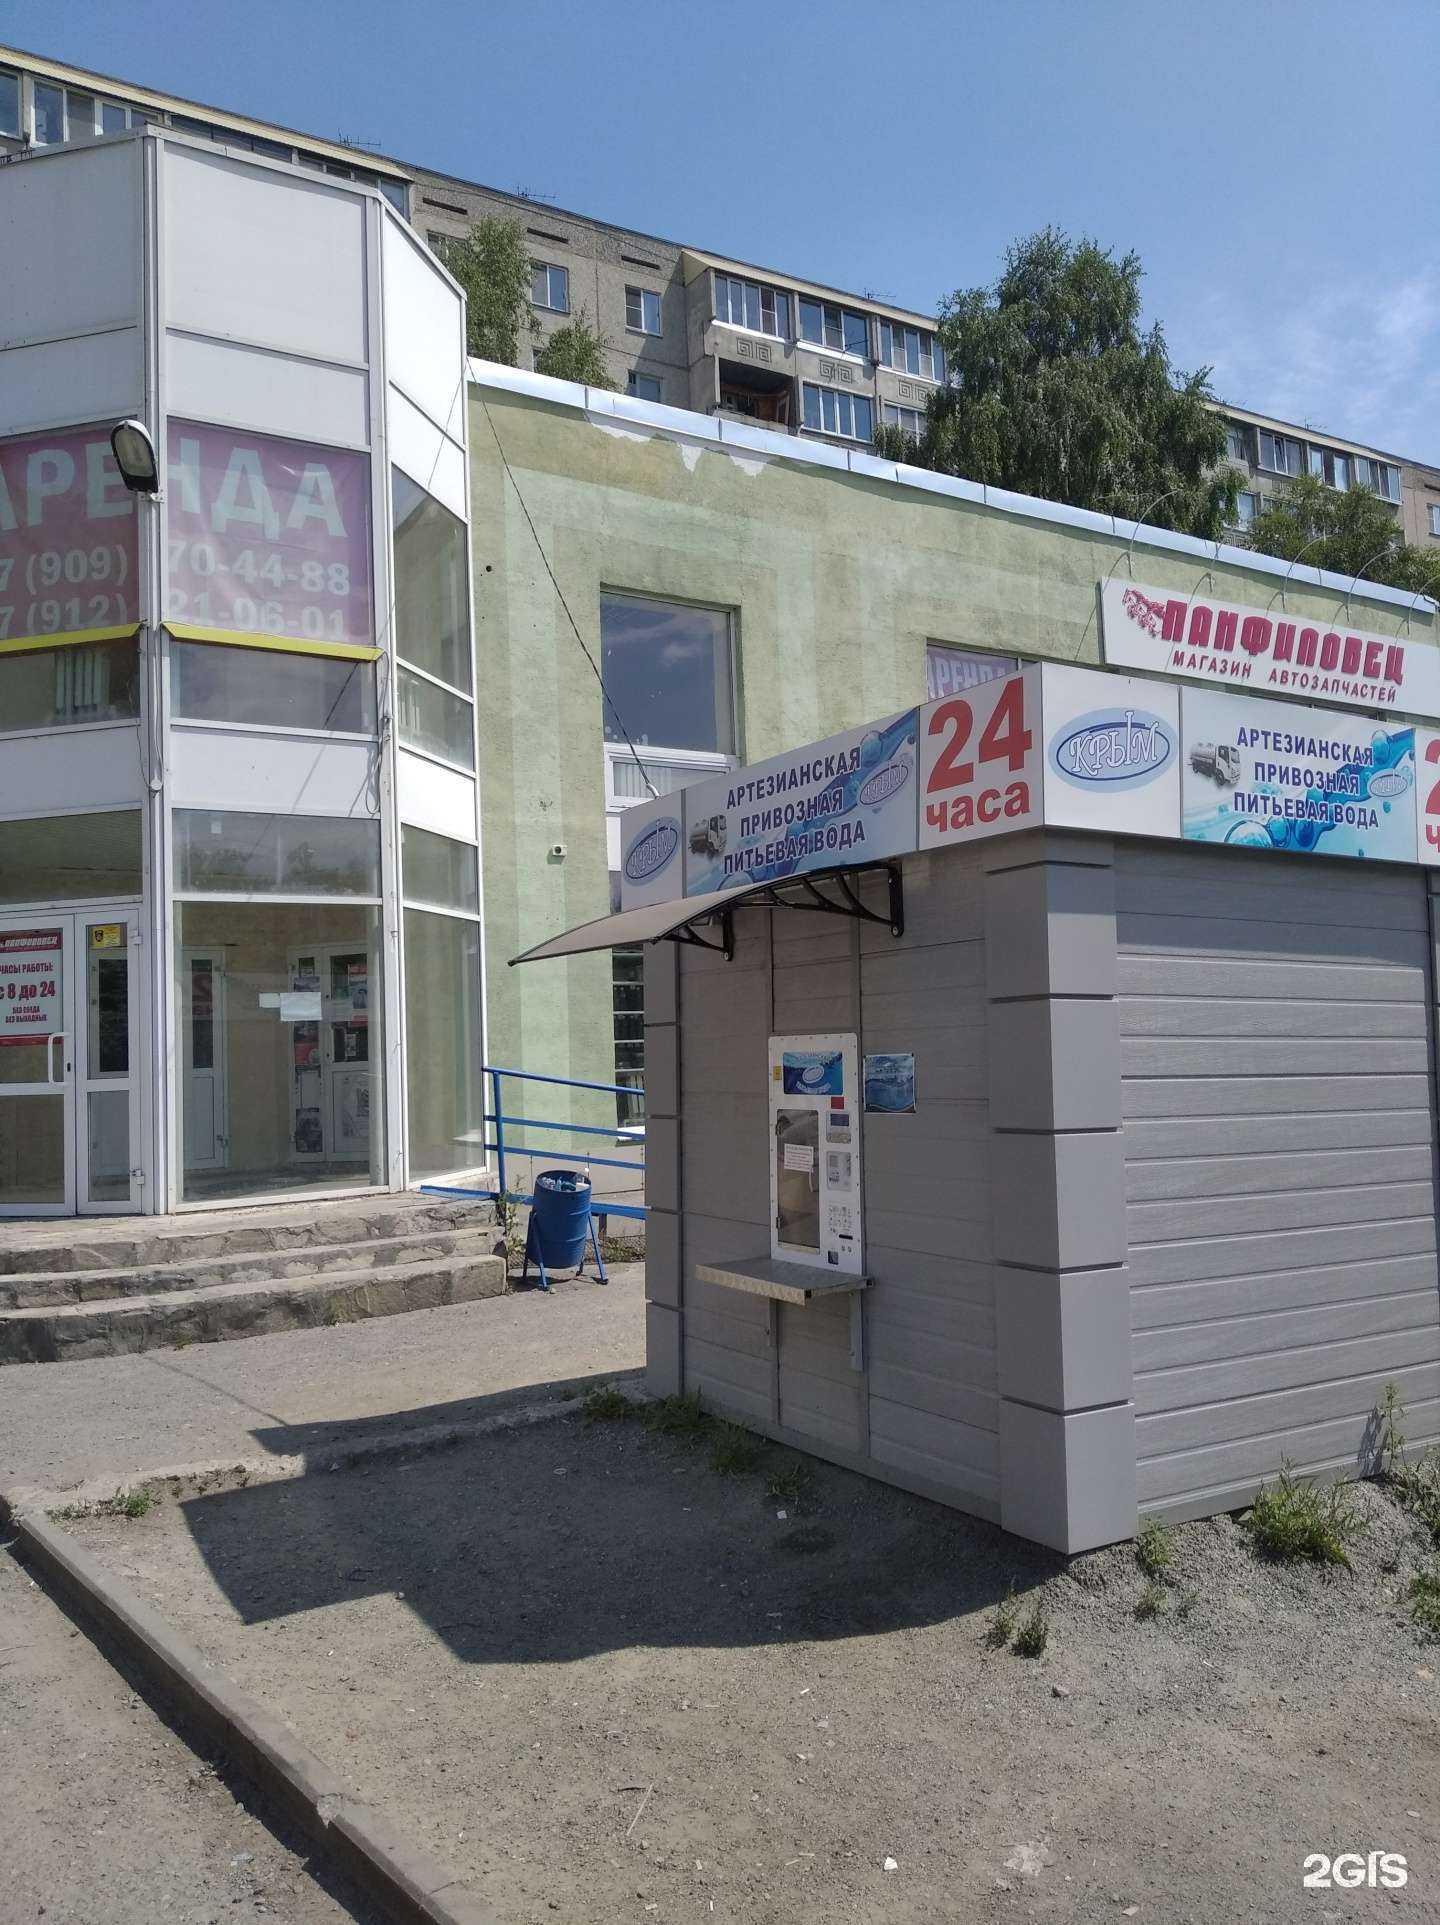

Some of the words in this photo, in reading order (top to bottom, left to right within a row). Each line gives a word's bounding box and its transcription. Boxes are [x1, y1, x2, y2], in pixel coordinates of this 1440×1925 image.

[26, 544, 128, 596] (909)
[26, 592, 128, 636] (912)
[1160, 598, 1405, 686] ПАНФИЛОВЕЦ
[1172, 650, 1253, 679] МАГАЗИН
[1268, 668, 1397, 703] АВТОЗАПЧАСТЕЙ
[926, 676, 1032, 794] 24
[1068, 709, 1160, 776] КРЫМ
[1237, 726, 1374, 767] АРТЕЗИАНСКАЯ
[726, 746, 862, 810] АРТЕЗИАНСКАЯ
[1253, 762, 1360, 795] ПРИВОЗНАЯ
[740, 787, 844, 838] ПРИВОЗНАЯ
[926, 779, 1031, 834] часа
[1233, 791, 1329, 823] ПИТЬЕВАЯ
[1333, 803, 1379, 830] ВОДА
[724, 832, 809, 875] ПИТЬЕВАЯ
[813, 819, 866, 852] ВОДА
[7, 982, 16, 1000] 8
[18, 983, 37, 1001] до
[40, 980, 56, 998] 24
